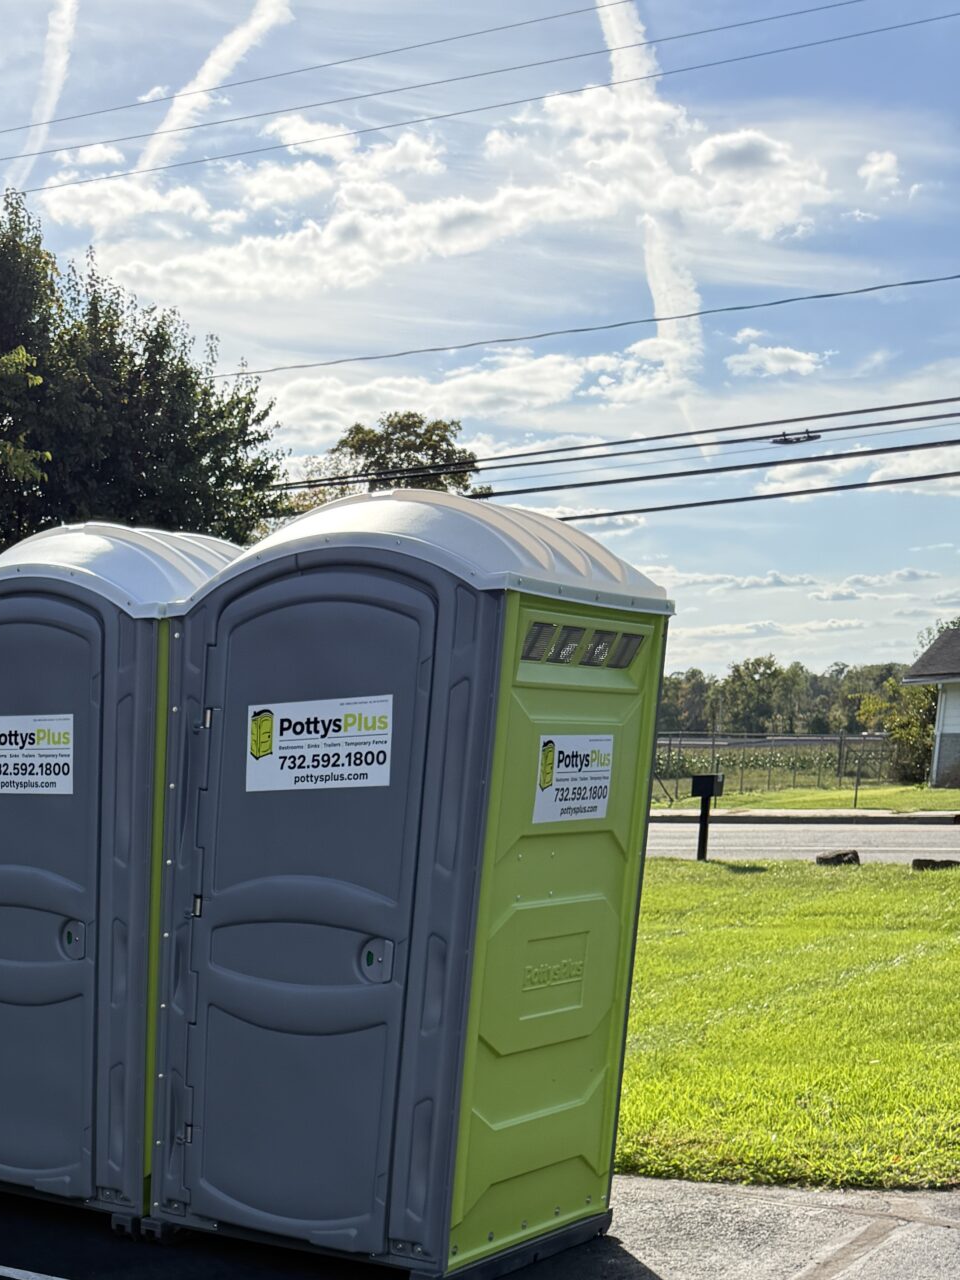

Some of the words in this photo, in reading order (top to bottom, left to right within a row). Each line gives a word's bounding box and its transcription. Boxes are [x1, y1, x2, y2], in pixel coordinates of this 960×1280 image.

[279, 713, 388, 738] PottysPlus
[344, 740, 371, 748] Temporary
[278, 750, 387, 770] 732.592.1800
[557, 749, 611, 772] PottysPlus
[1, 780, 56, 789] pottysplus.com
[294, 772, 368, 784] pottysplus.com
[554, 785, 608, 803] 732.592.1800
[560, 804, 598, 817] pottysplus.com
